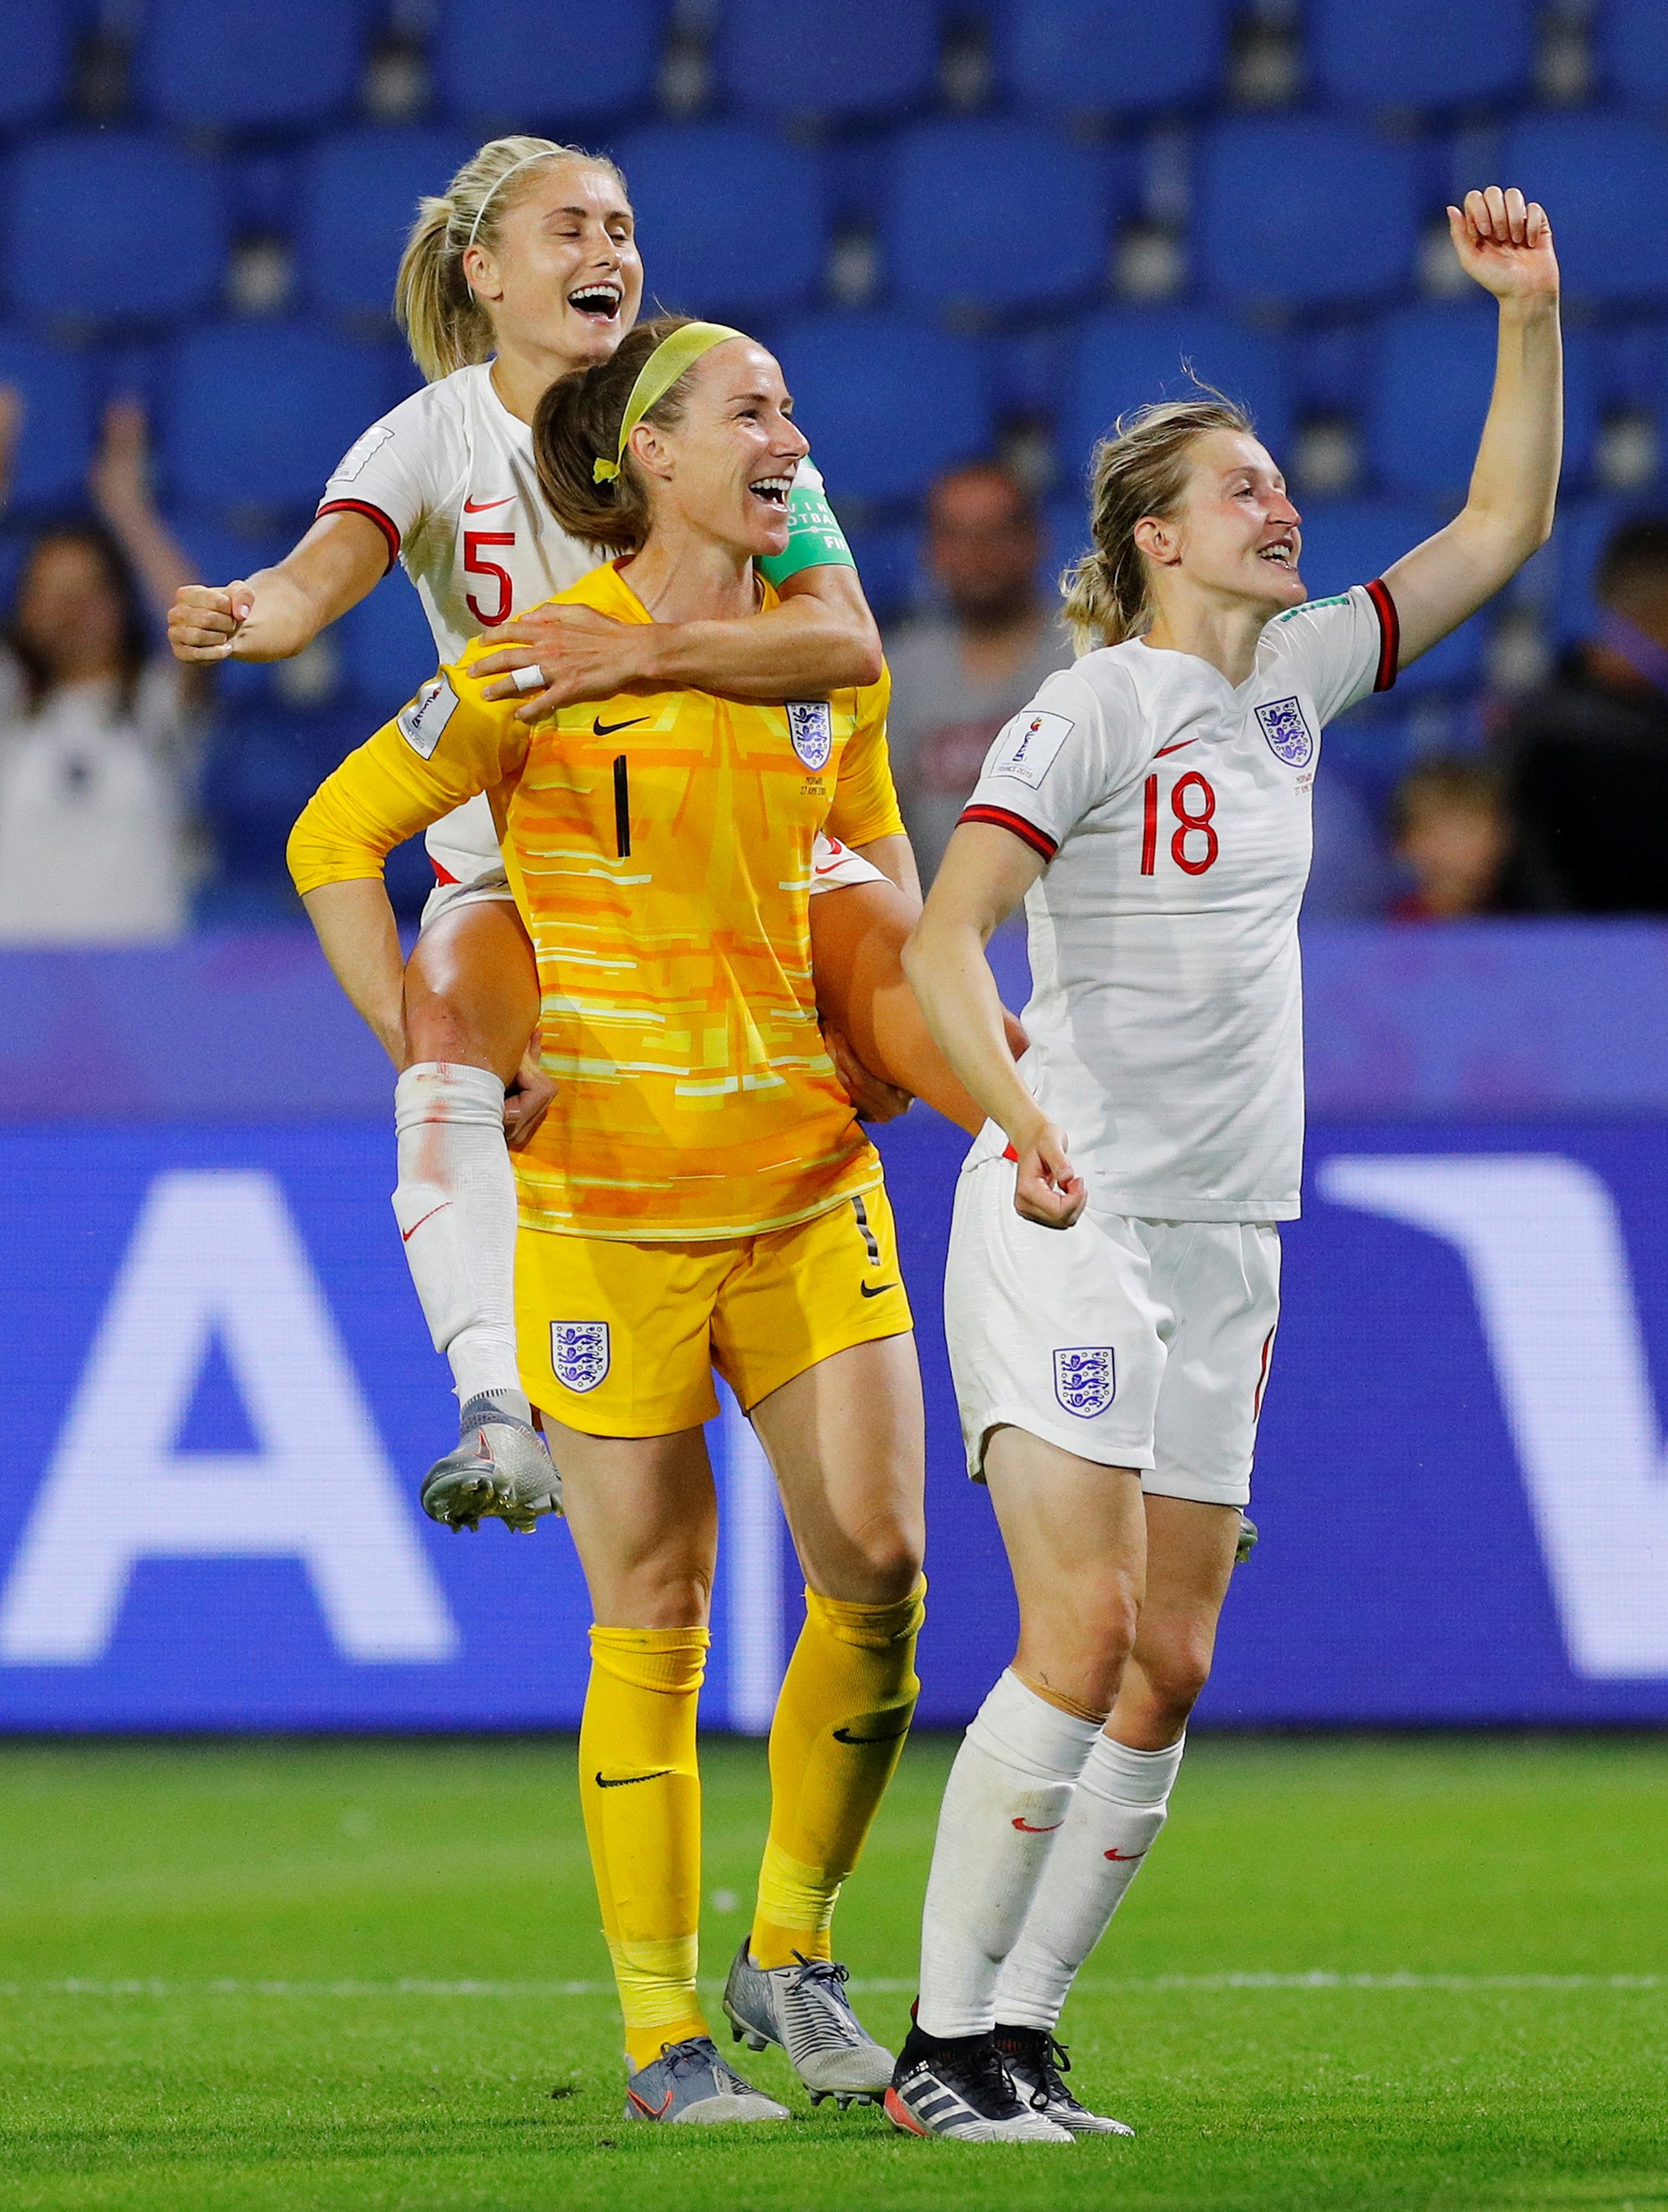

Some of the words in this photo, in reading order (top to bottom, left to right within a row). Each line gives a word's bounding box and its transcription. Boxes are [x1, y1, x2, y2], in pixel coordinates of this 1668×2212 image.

[465, 531, 515, 627] 5
[614, 755, 631, 857] 1
[1141, 771, 1218, 875] 18
[0, 1167, 460, 1665] A
